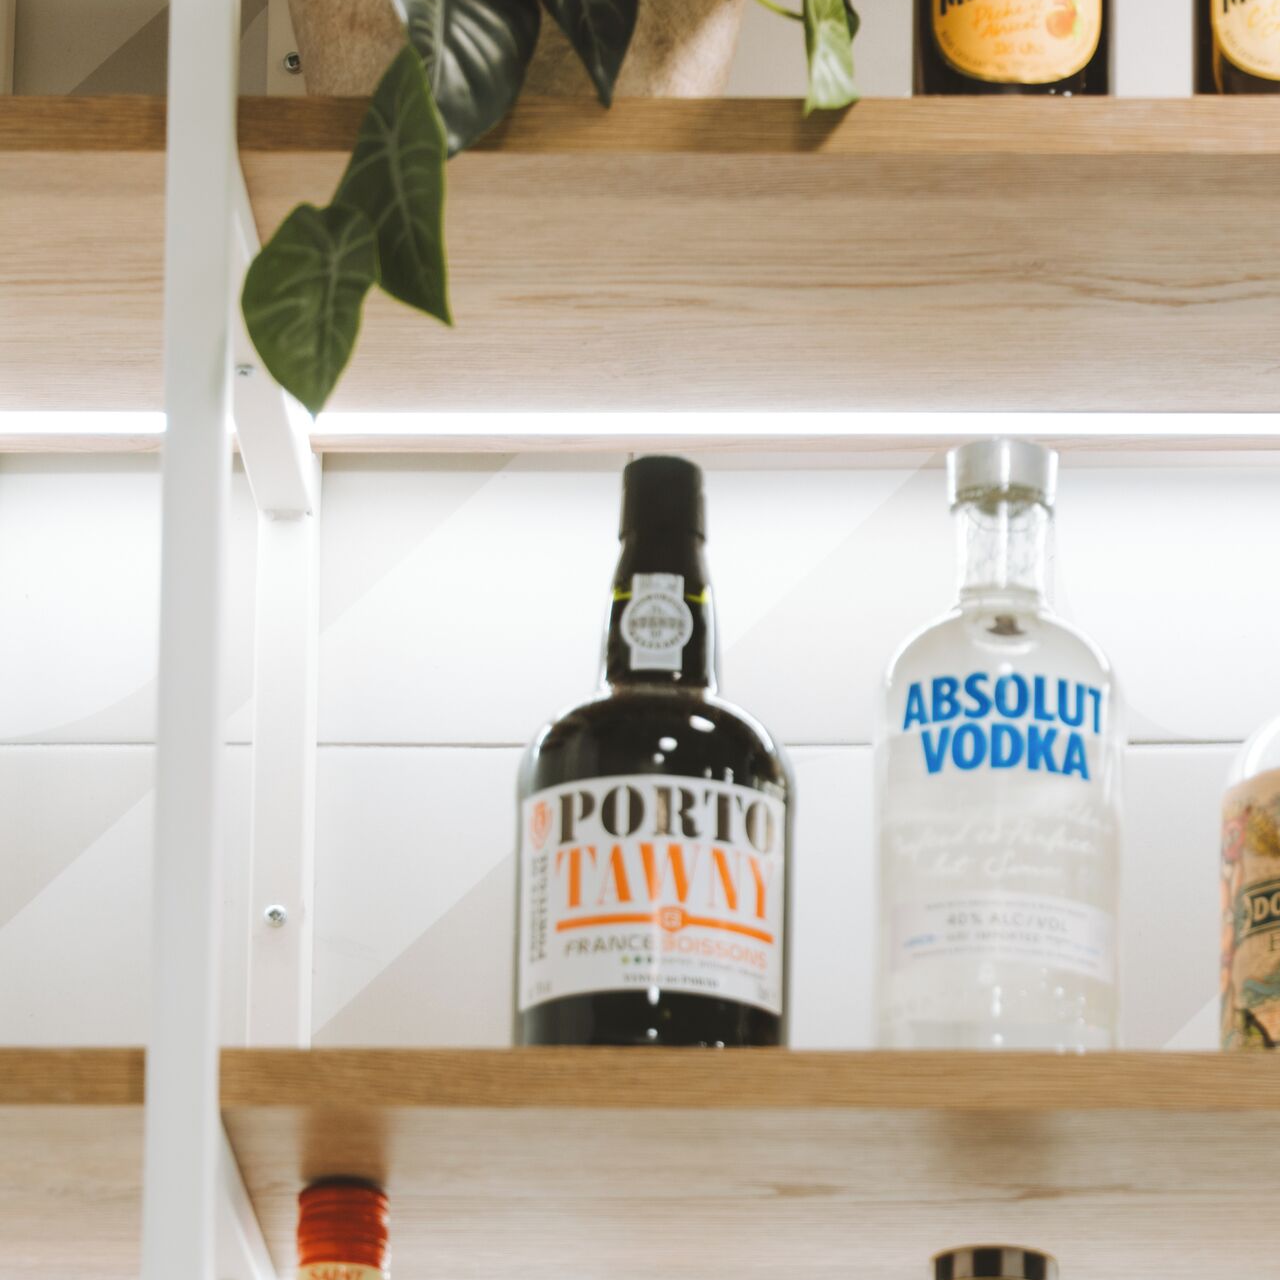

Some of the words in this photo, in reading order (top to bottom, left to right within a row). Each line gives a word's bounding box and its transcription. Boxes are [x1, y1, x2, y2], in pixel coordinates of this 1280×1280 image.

[903, 672, 1103, 734] ABSOLUT
[921, 722, 1091, 782] VODKA
[558, 782, 776, 857] PORTO
[555, 841, 774, 921] TAWNY
[564, 933, 653, 959] FRANCE
[660, 936, 769, 972] BOISSONS
